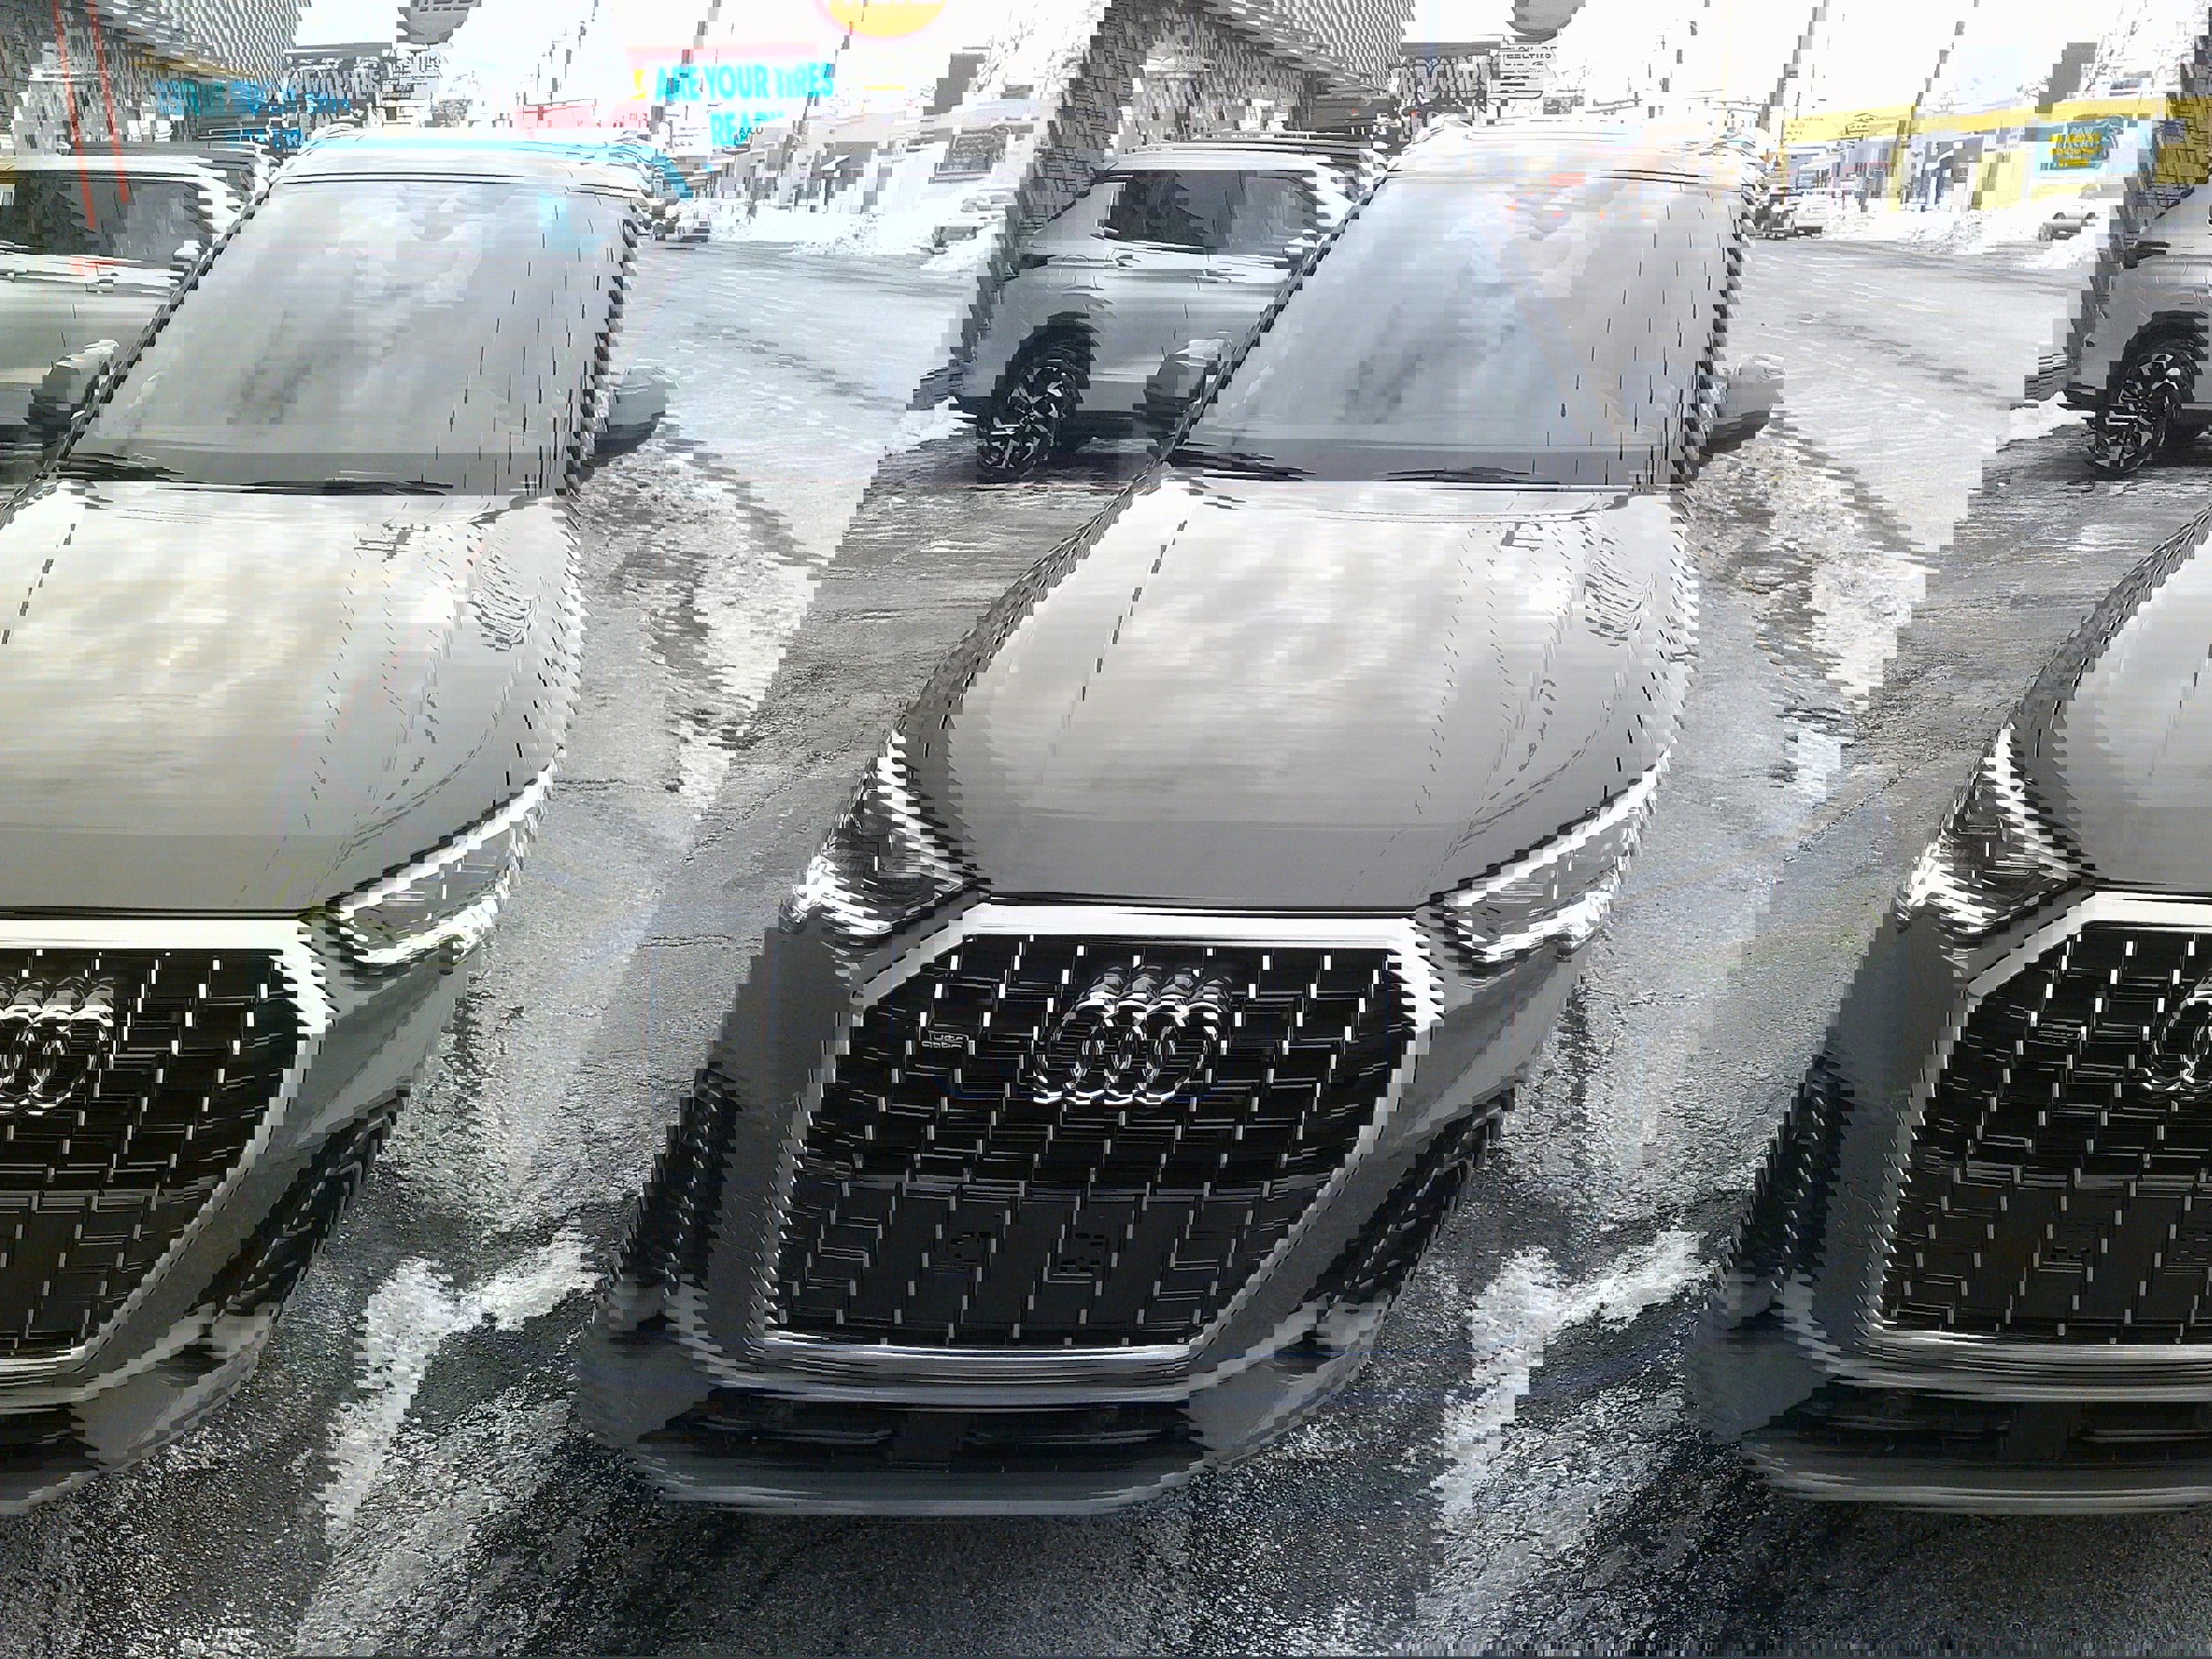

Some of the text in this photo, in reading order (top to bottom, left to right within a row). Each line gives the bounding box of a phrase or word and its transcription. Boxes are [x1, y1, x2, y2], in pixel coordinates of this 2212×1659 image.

[654, 63, 834, 101] ARE YOUR TIRES
[709, 111, 785, 147] READ
